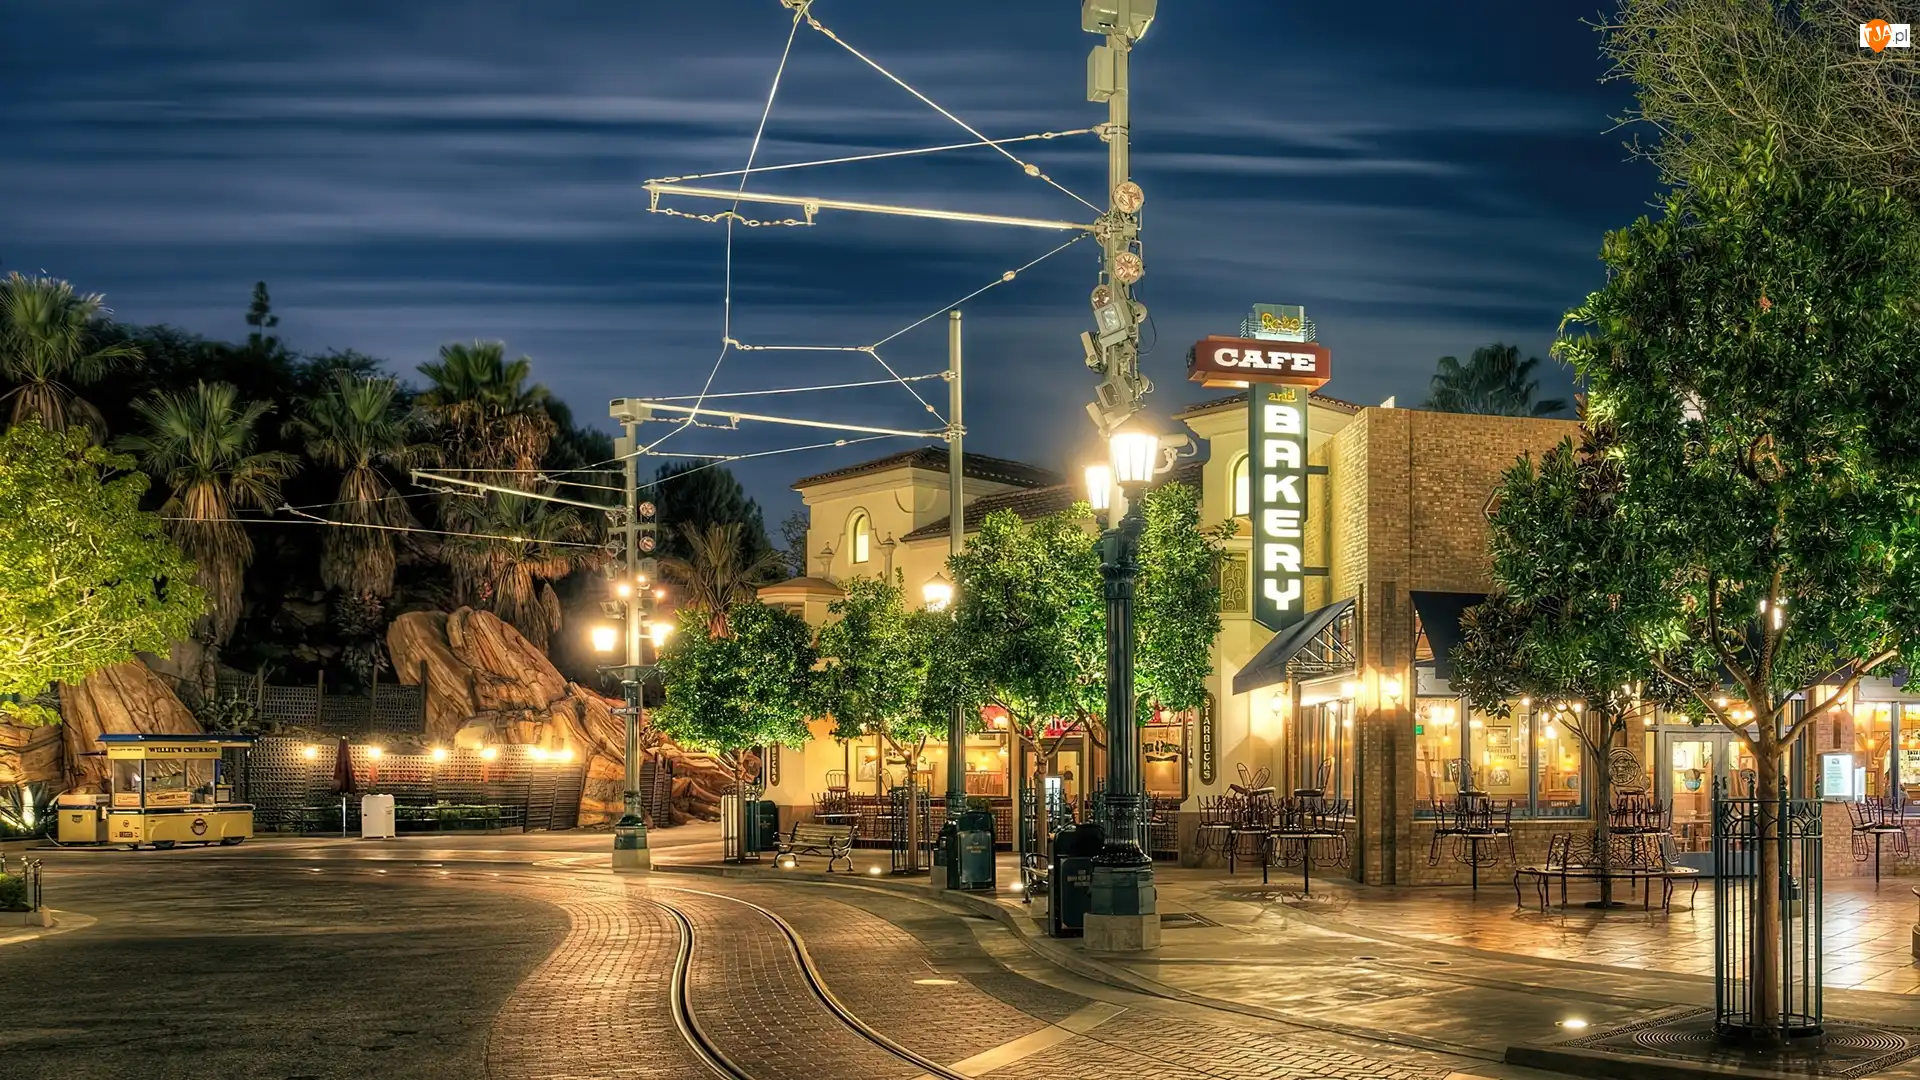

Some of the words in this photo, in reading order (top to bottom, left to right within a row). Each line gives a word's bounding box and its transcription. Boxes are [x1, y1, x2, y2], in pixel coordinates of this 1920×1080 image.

[1214, 348, 1315, 371] CAFE
[1264, 404, 1300, 611] BAKERY
[1203, 698, 1211, 779] STARBUCKS
